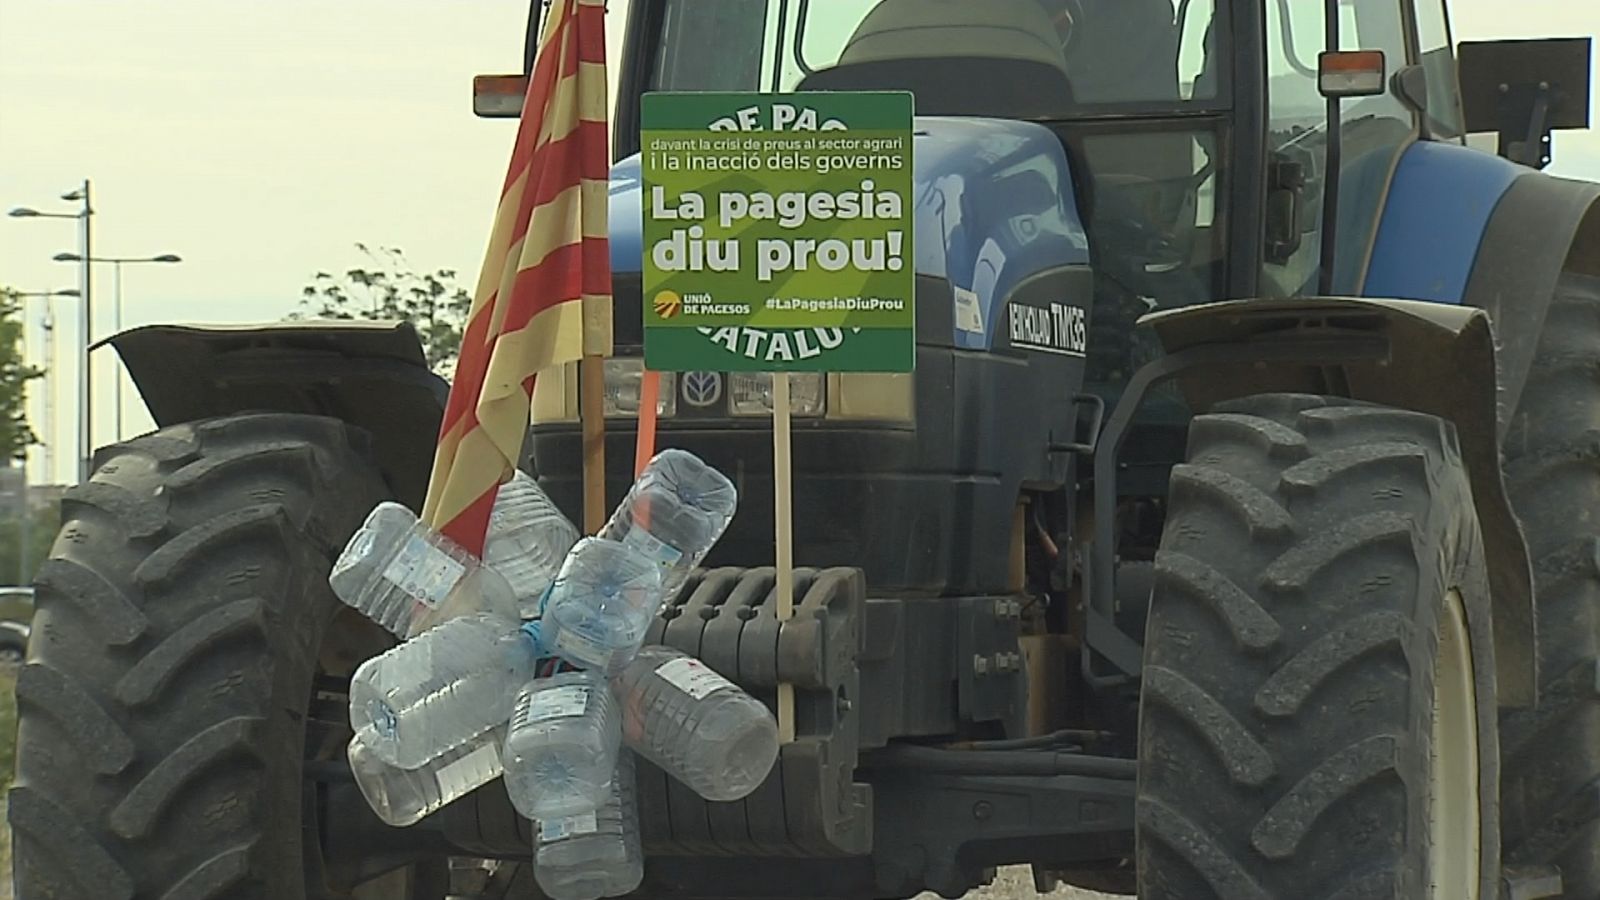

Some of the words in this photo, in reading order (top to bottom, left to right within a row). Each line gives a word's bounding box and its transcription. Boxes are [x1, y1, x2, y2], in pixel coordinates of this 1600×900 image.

[651, 139, 696, 150] davant
[699, 139, 711, 150] la
[713, 138, 740, 150] crisi
[743, 138, 761, 150] de
[763, 140, 802, 152] preus
[803, 138, 816, 150] al
[818, 139, 862, 150] sector
[863, 137, 902, 152] agrari
[651, 152, 656, 170] i
[662, 152, 680, 170] la
[686, 152, 761, 170] inacció
[766, 151, 811, 170] dels
[816, 155, 902, 174] governs
[652, 186, 705, 219] La
[719, 180, 902, 228] pagesia
[652, 226, 739, 271] diu
[758, 231, 903, 281] prou!
[683, 292, 712, 304] UNIÓ
[683, 304, 699, 314] DE
[700, 304, 750, 314] PAGESOS
[765, 297, 904, 311] #LaPagesiaDiuProu
[1050, 302, 1086, 353] TM135
[698, 327, 861, 360] ATALU
